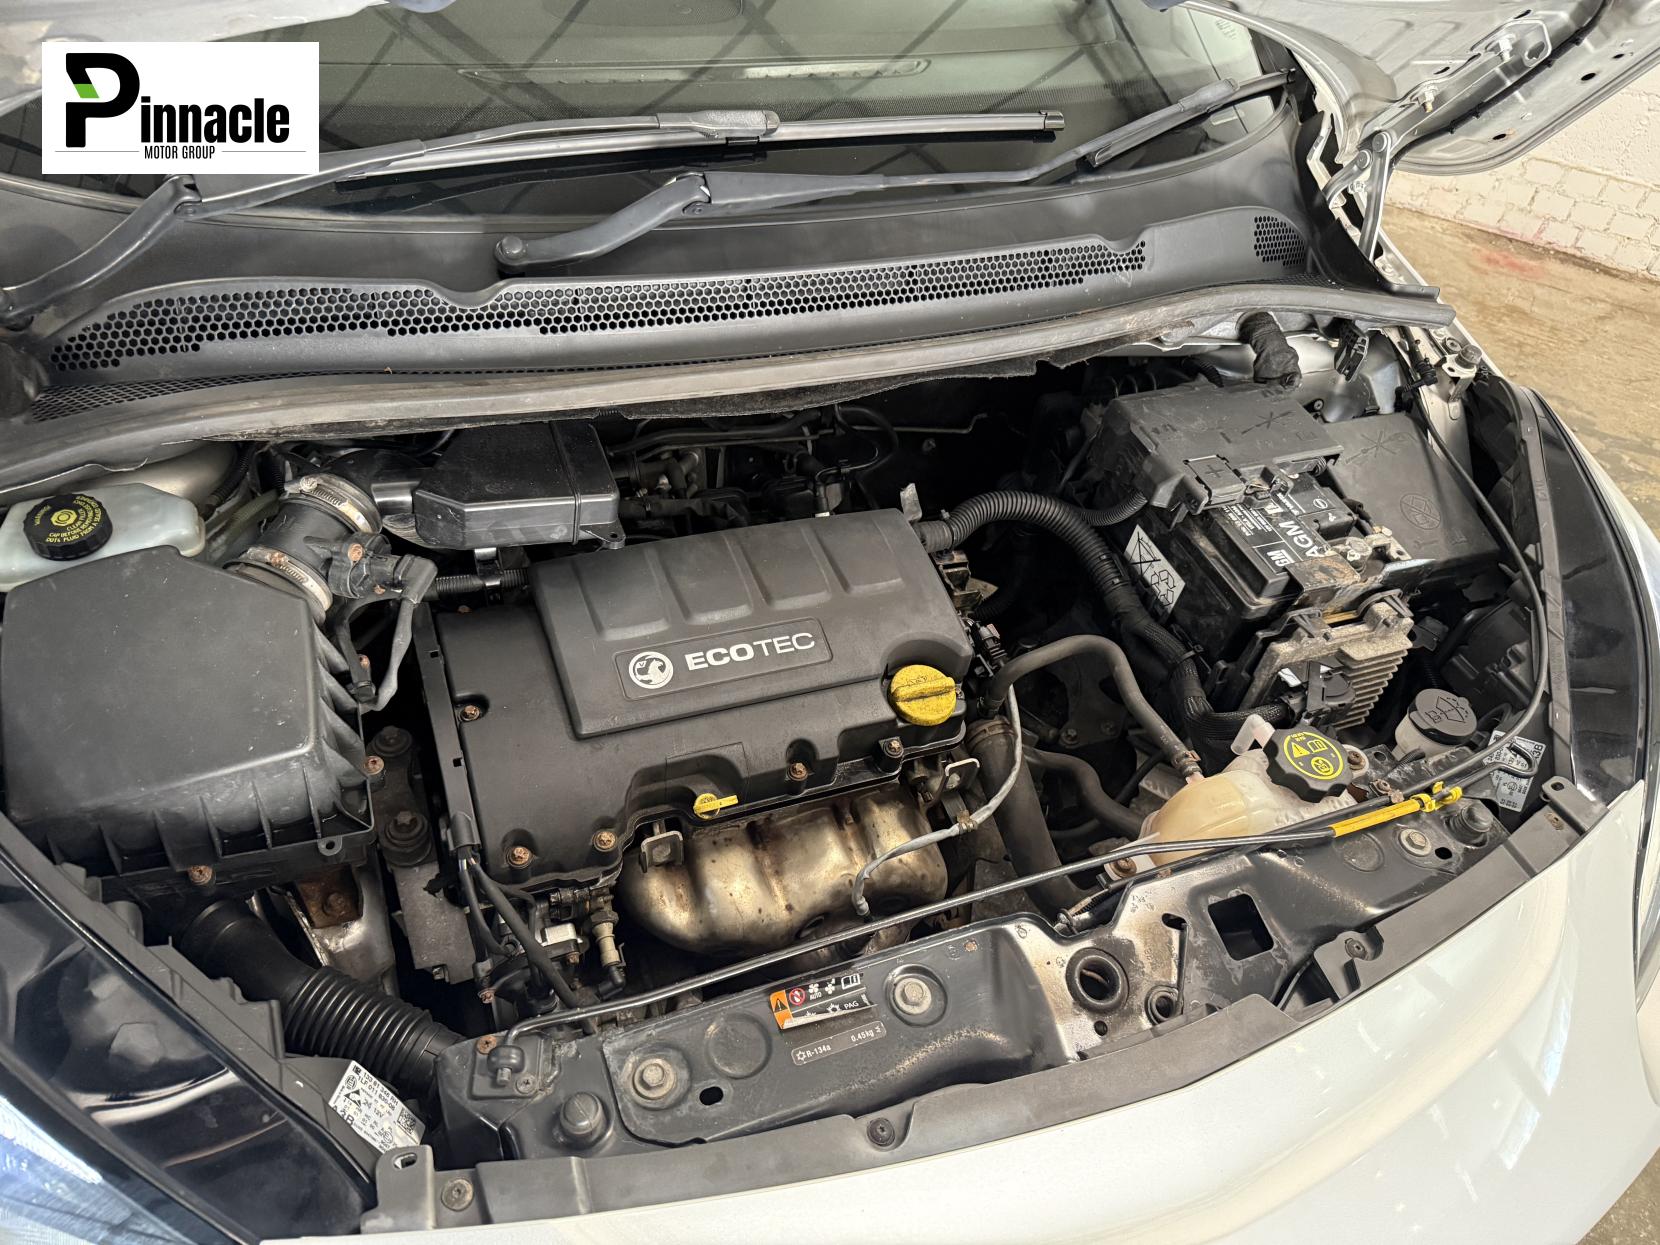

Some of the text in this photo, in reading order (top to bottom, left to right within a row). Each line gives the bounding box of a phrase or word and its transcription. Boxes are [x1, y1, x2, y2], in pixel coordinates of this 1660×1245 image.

[67, 521, 83, 531] CLEAN
[63, 534, 80, 543] FLUID
[1279, 521, 1325, 557] AGM
[1267, 550, 1293, 567] GM
[684, 632, 816, 671] ECOTEC
[809, 991, 822, 1000] AUTO
[843, 1000, 860, 1010] PAG
[806, 1029, 875, 1058] R-134a 0.45kg
